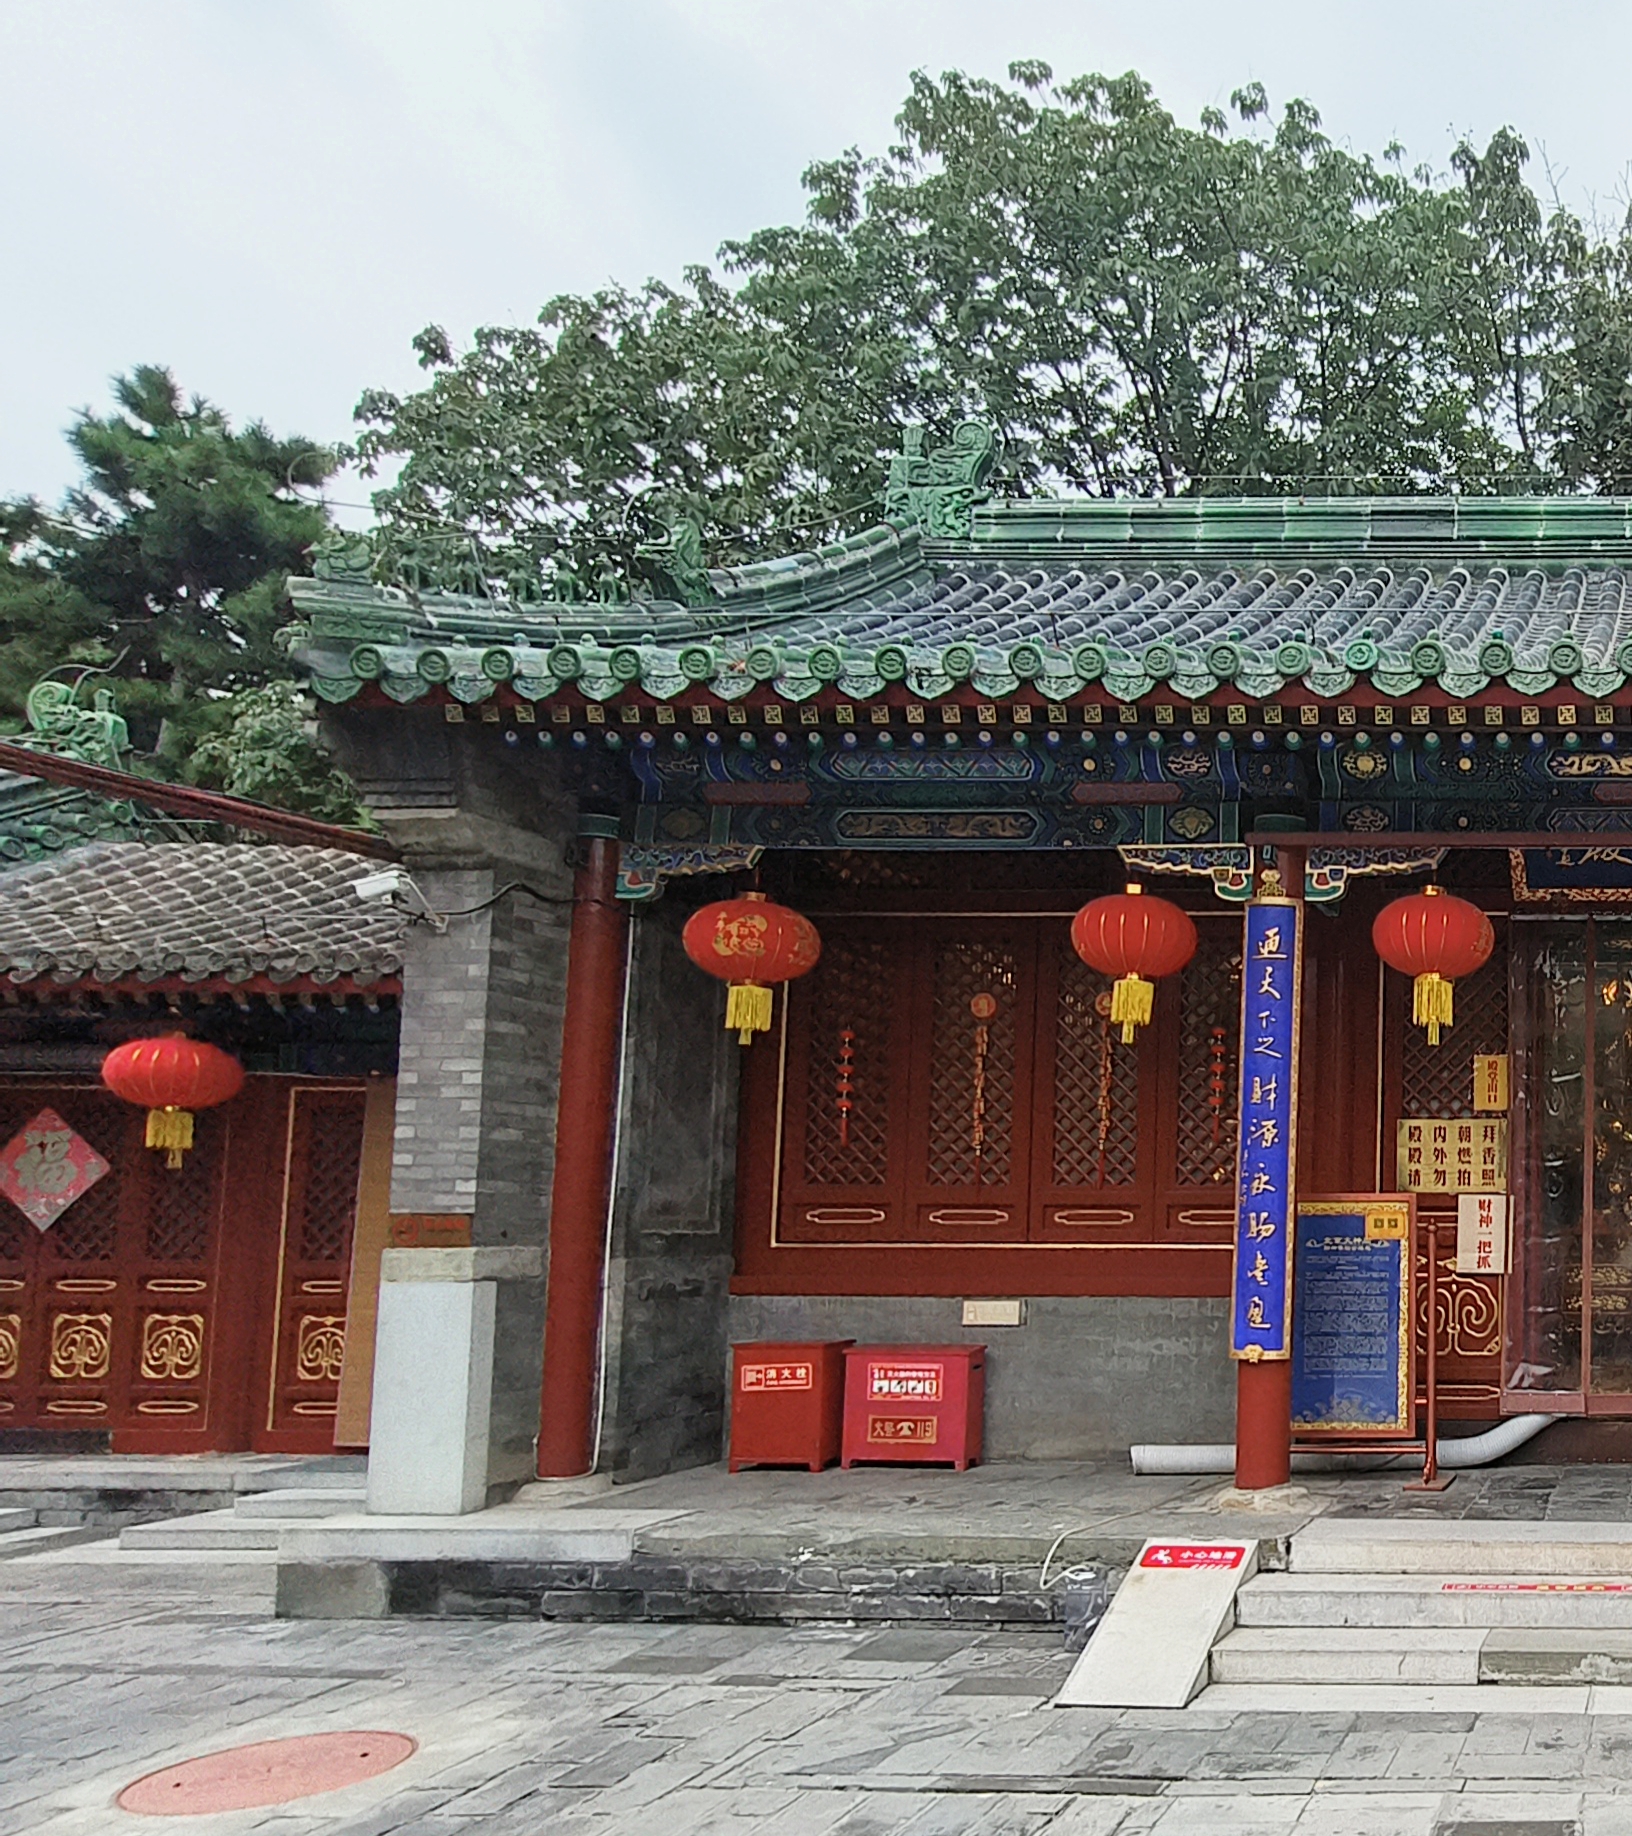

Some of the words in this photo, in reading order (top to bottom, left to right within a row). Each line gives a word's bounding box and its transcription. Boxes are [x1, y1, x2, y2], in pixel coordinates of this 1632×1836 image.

[1486, 1059, 1499, 1104] 殿堂出口
[1408, 1125, 1497, 1144] 殿内朝拜
[1408, 1146, 1497, 1166] 殿外燃香
[1408, 1168, 1497, 1187] 请勿拍照
[1476, 1198, 1494, 1269] 财神一把抓
[765, 1366, 808, 1379] 消火栓
[916, 1421, 933, 1438] 119
